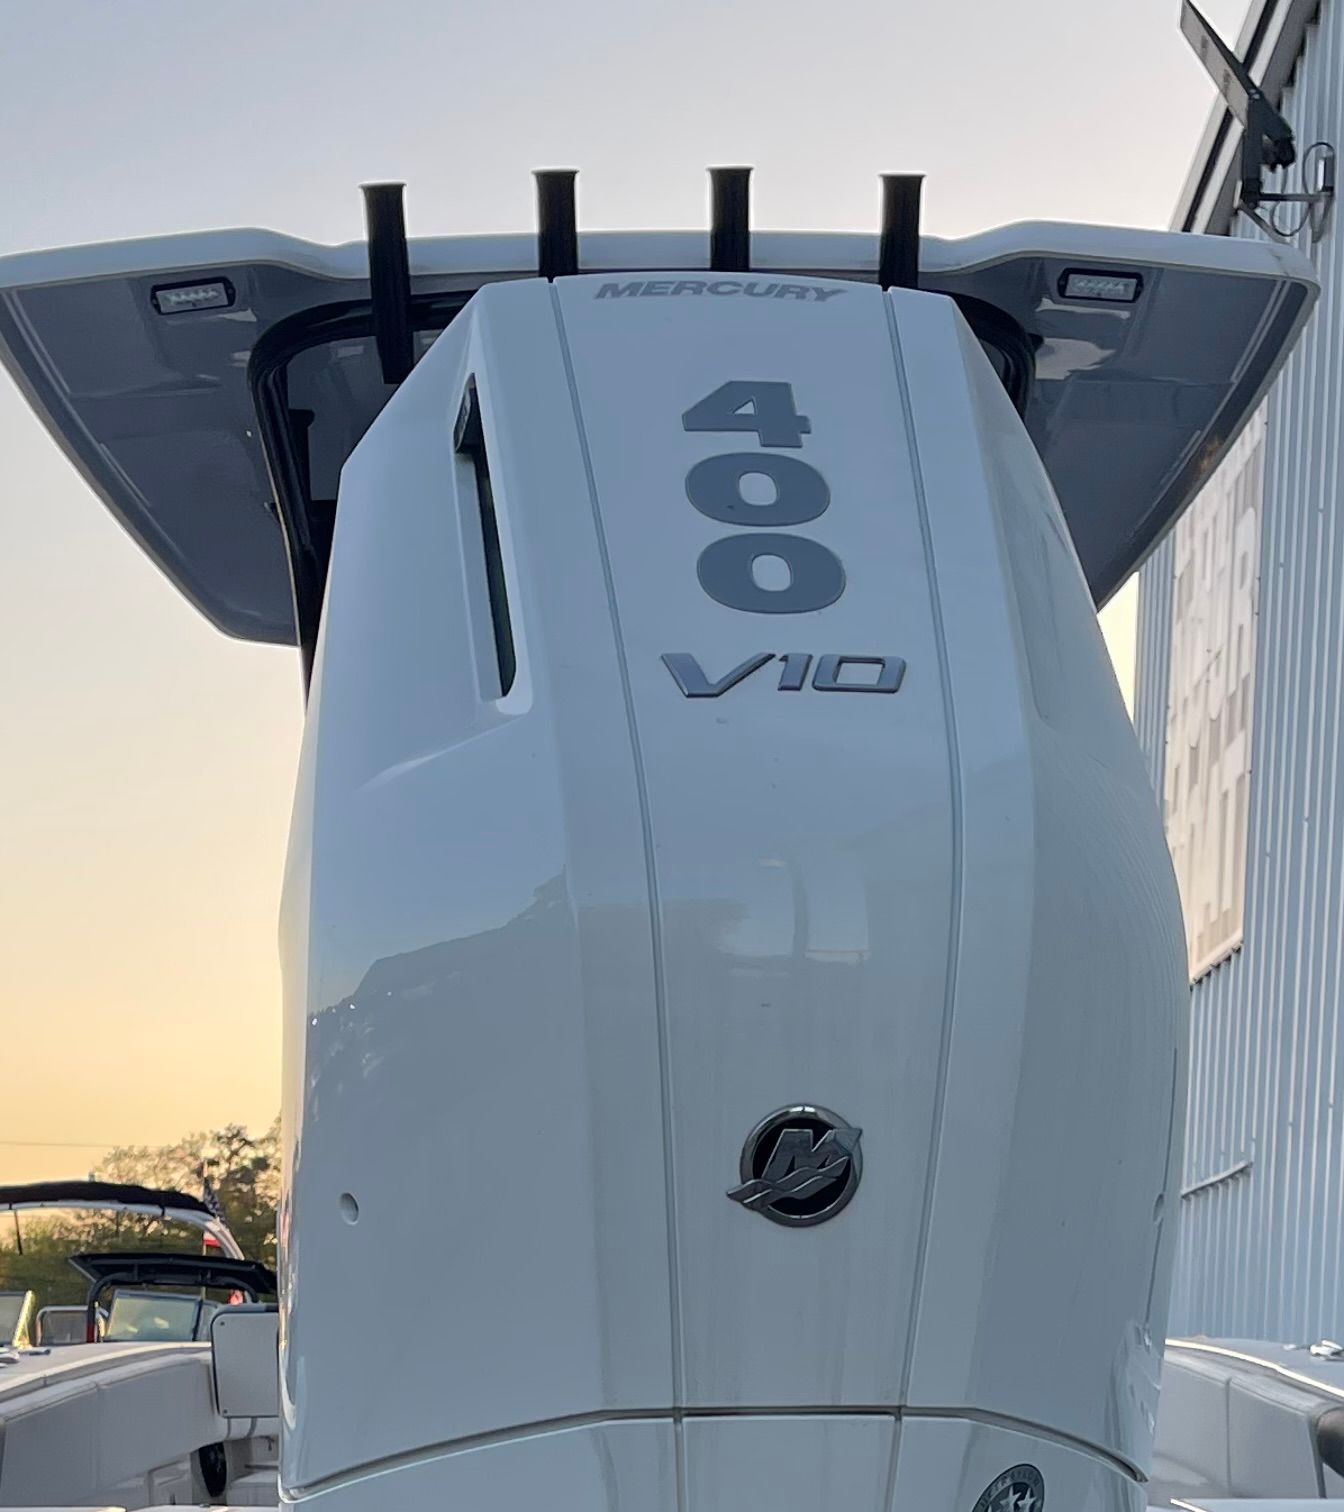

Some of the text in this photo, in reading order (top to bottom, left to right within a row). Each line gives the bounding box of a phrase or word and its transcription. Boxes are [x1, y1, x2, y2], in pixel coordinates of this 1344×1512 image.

[593, 281, 849, 302] MERCURY
[681, 380, 847, 615] 400
[659, 651, 907, 699] V10
